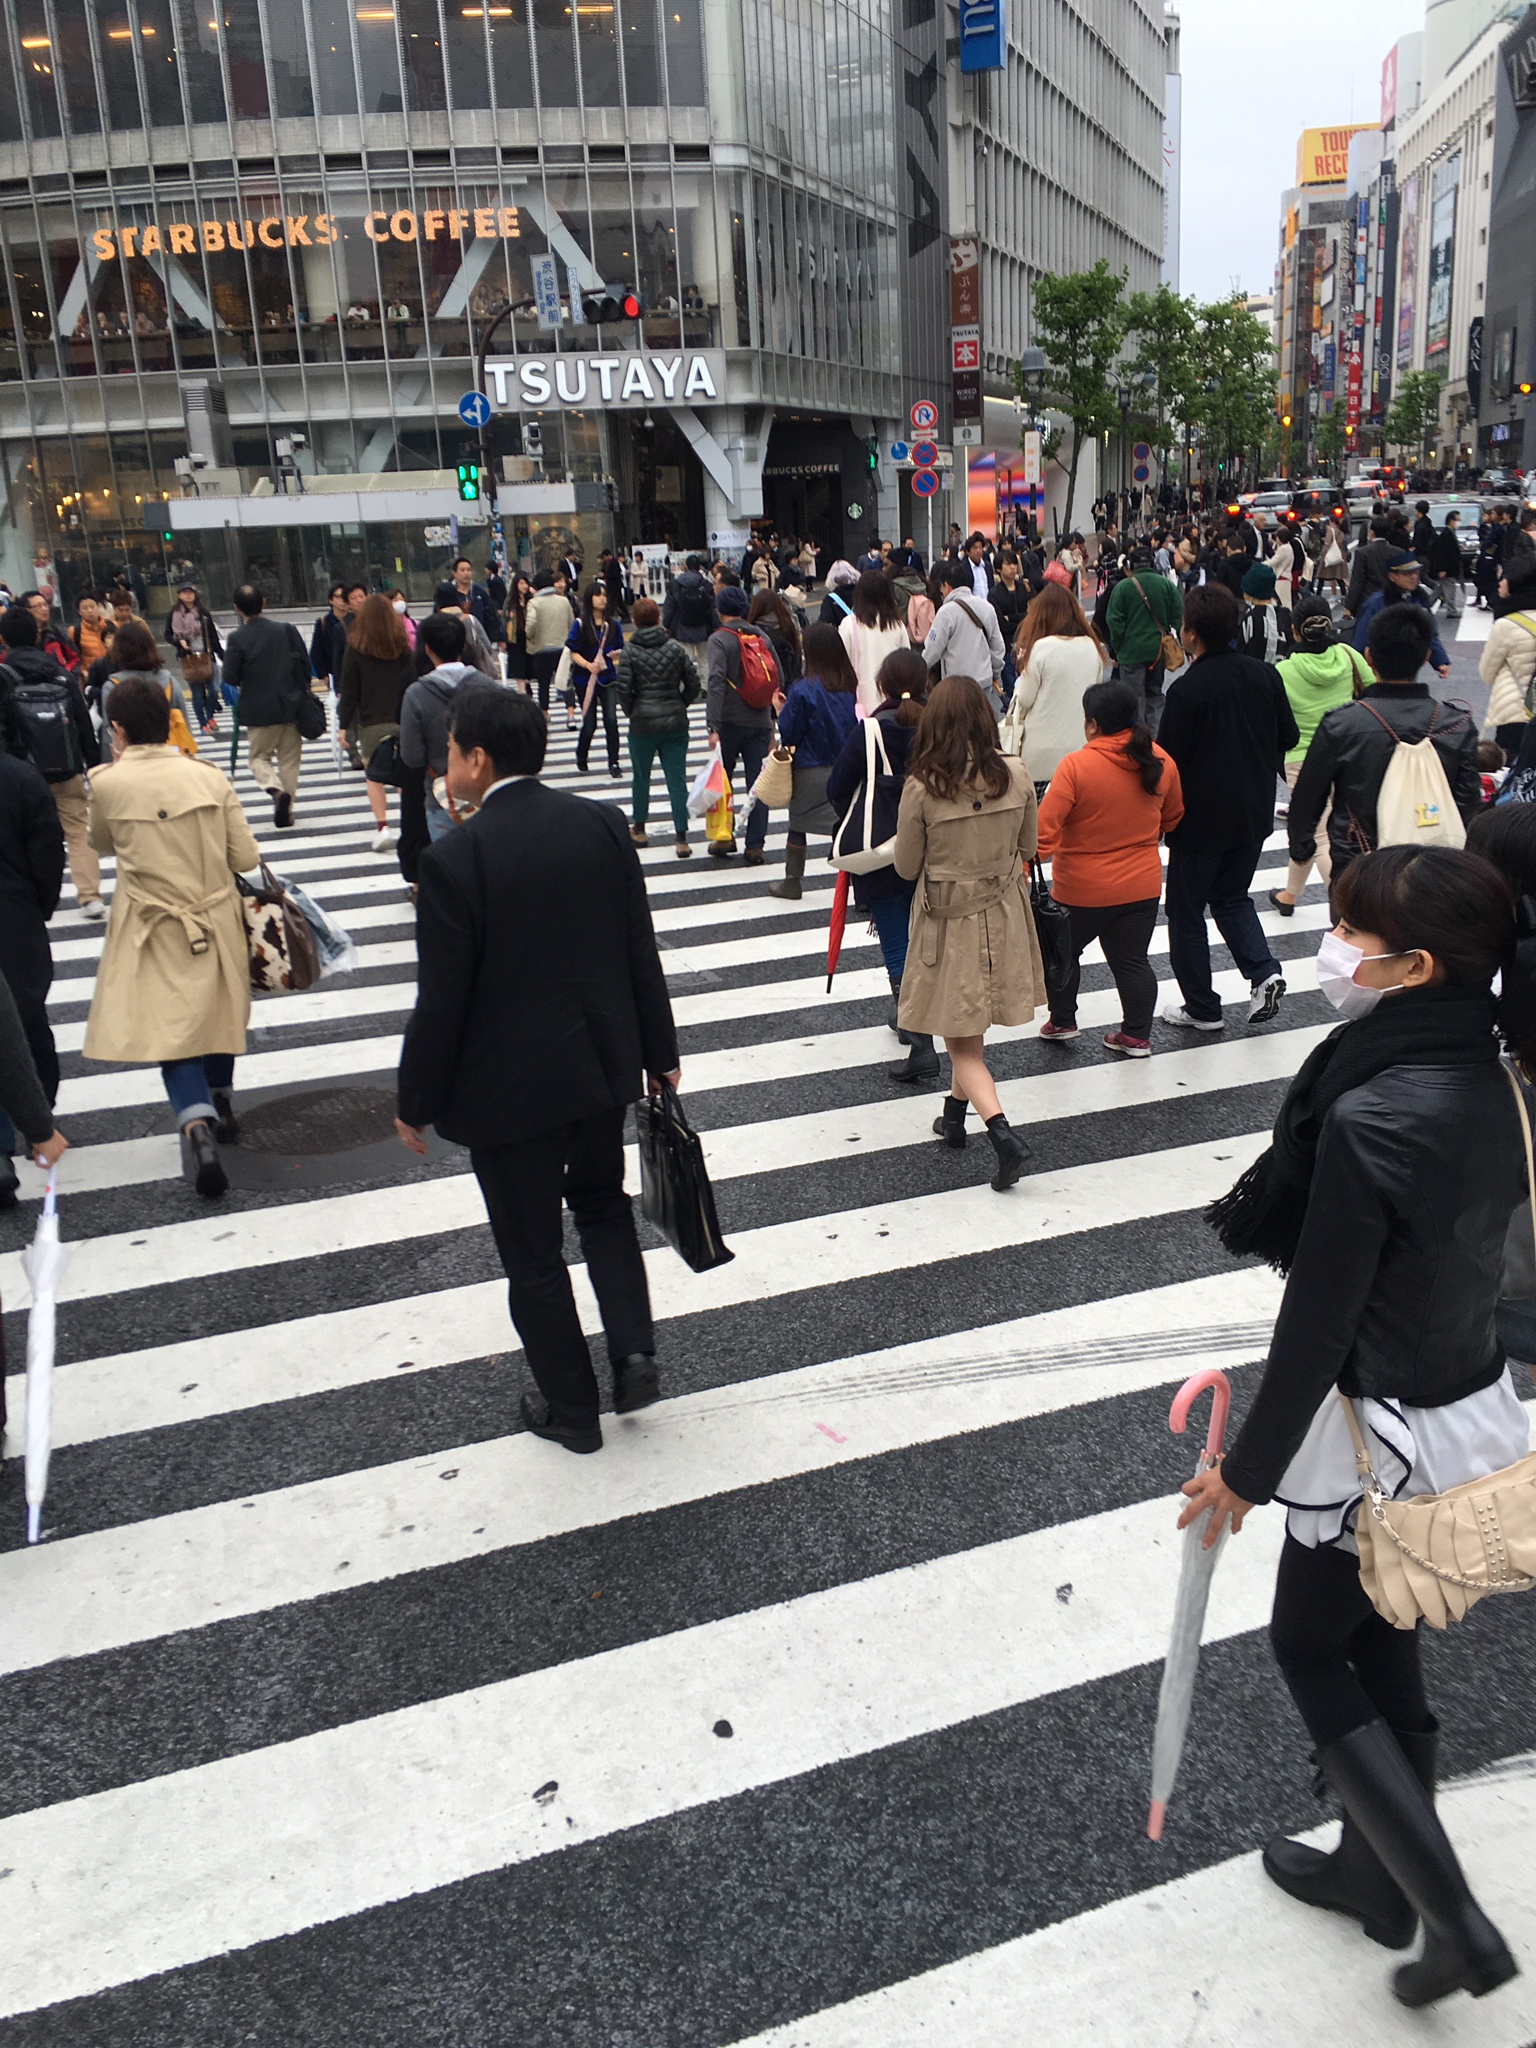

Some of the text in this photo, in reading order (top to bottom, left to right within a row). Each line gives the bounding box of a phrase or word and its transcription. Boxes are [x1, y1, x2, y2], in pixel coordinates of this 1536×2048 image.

[91, 207, 521, 262] STARBUCKS COFFEE
[535, 270, 544, 300] Shibuya
[542, 260, 559, 323] 渋谷駅前
[952, 328, 979, 337] TSUTAYA
[956, 343, 975, 365] 本
[484, 355, 718, 406] TSUTAYA
[956, 387, 977, 396] WIRED
[804, 463, 840, 473] COFFEE
[1414, 803, 1439, 828] L
